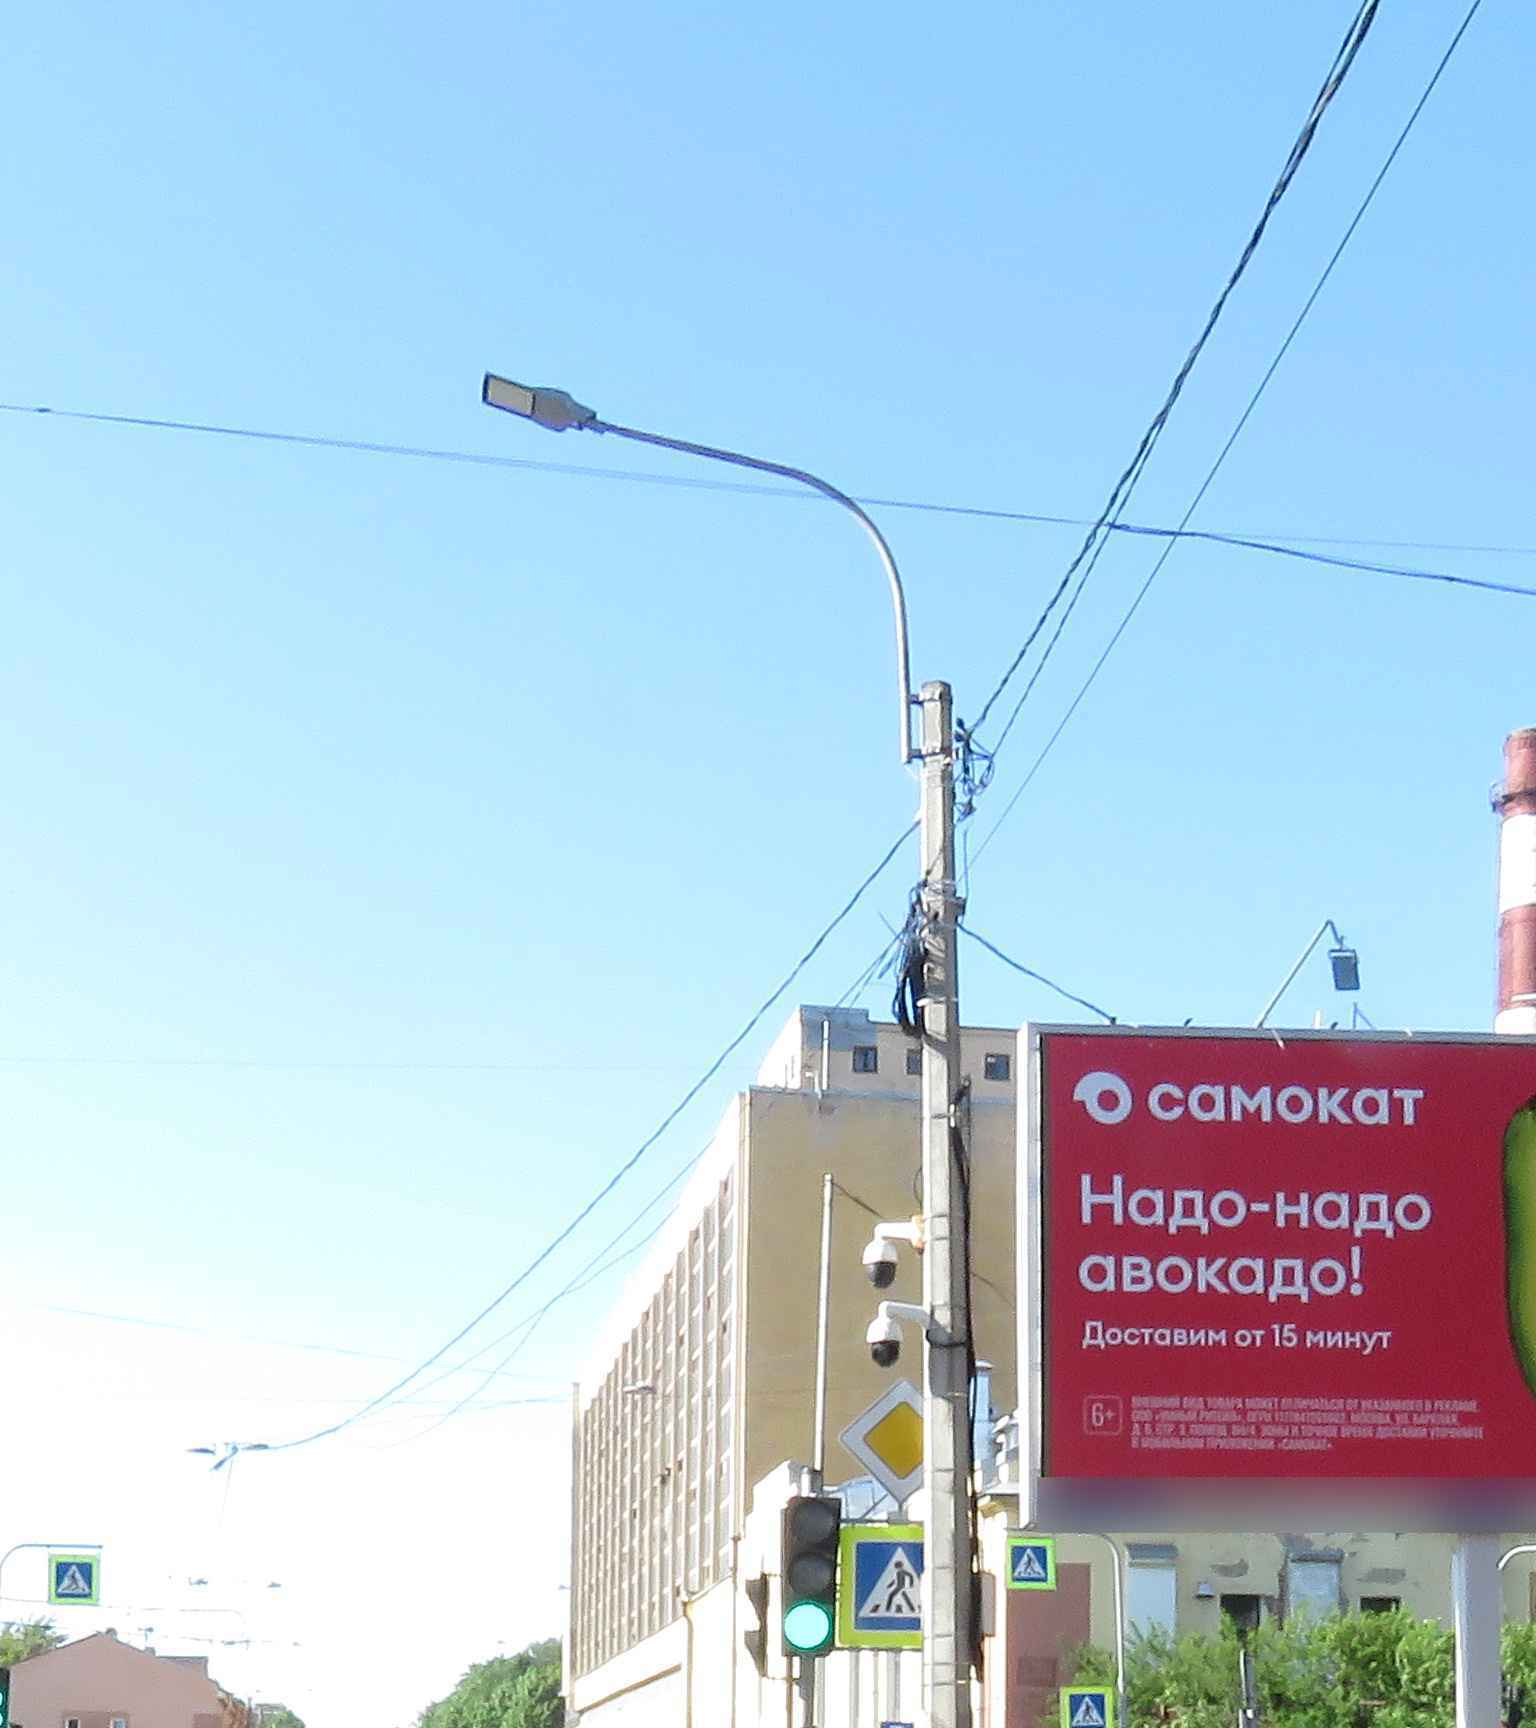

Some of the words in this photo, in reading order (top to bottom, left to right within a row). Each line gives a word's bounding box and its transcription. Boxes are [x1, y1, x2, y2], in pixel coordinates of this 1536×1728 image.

[1147, 1083, 1424, 1125] самокат
[1081, 1173, 1431, 1238] Надо-надо
[1078, 1245, 1363, 1303] авокадо!
[1082, 1320, 1227, 1350] Доставим
[1234, 1329, 1266, 1347] от
[1271, 1323, 1298, 1348] 15
[1305, 1330, 1392, 1355] минут
[1091, 1402, 1114, 1427] 6+
